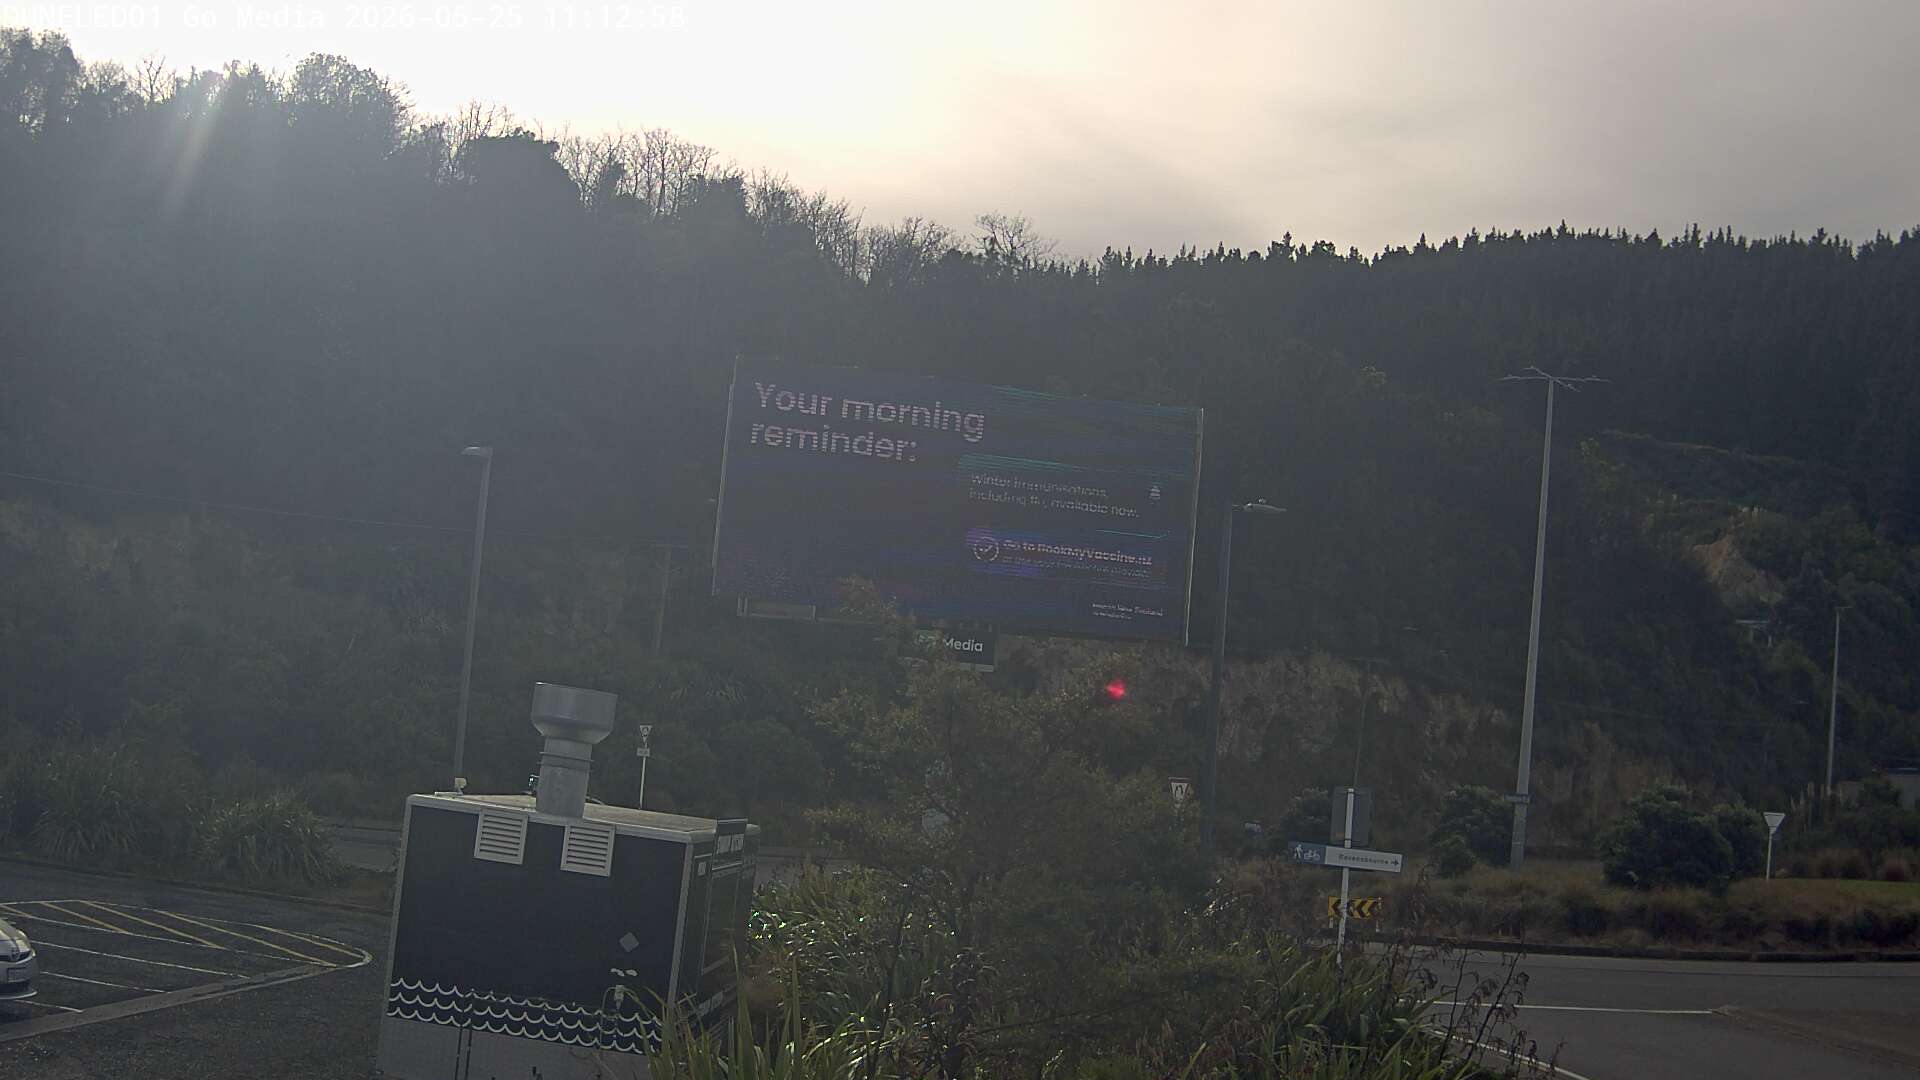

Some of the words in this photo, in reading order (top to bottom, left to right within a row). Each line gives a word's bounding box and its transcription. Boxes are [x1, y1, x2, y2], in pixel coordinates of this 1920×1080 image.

[754, 381, 833, 416] Your
[841, 398, 985, 443] morning
[750, 422, 918, 463] reminder:
[942, 637, 984, 653] Media
